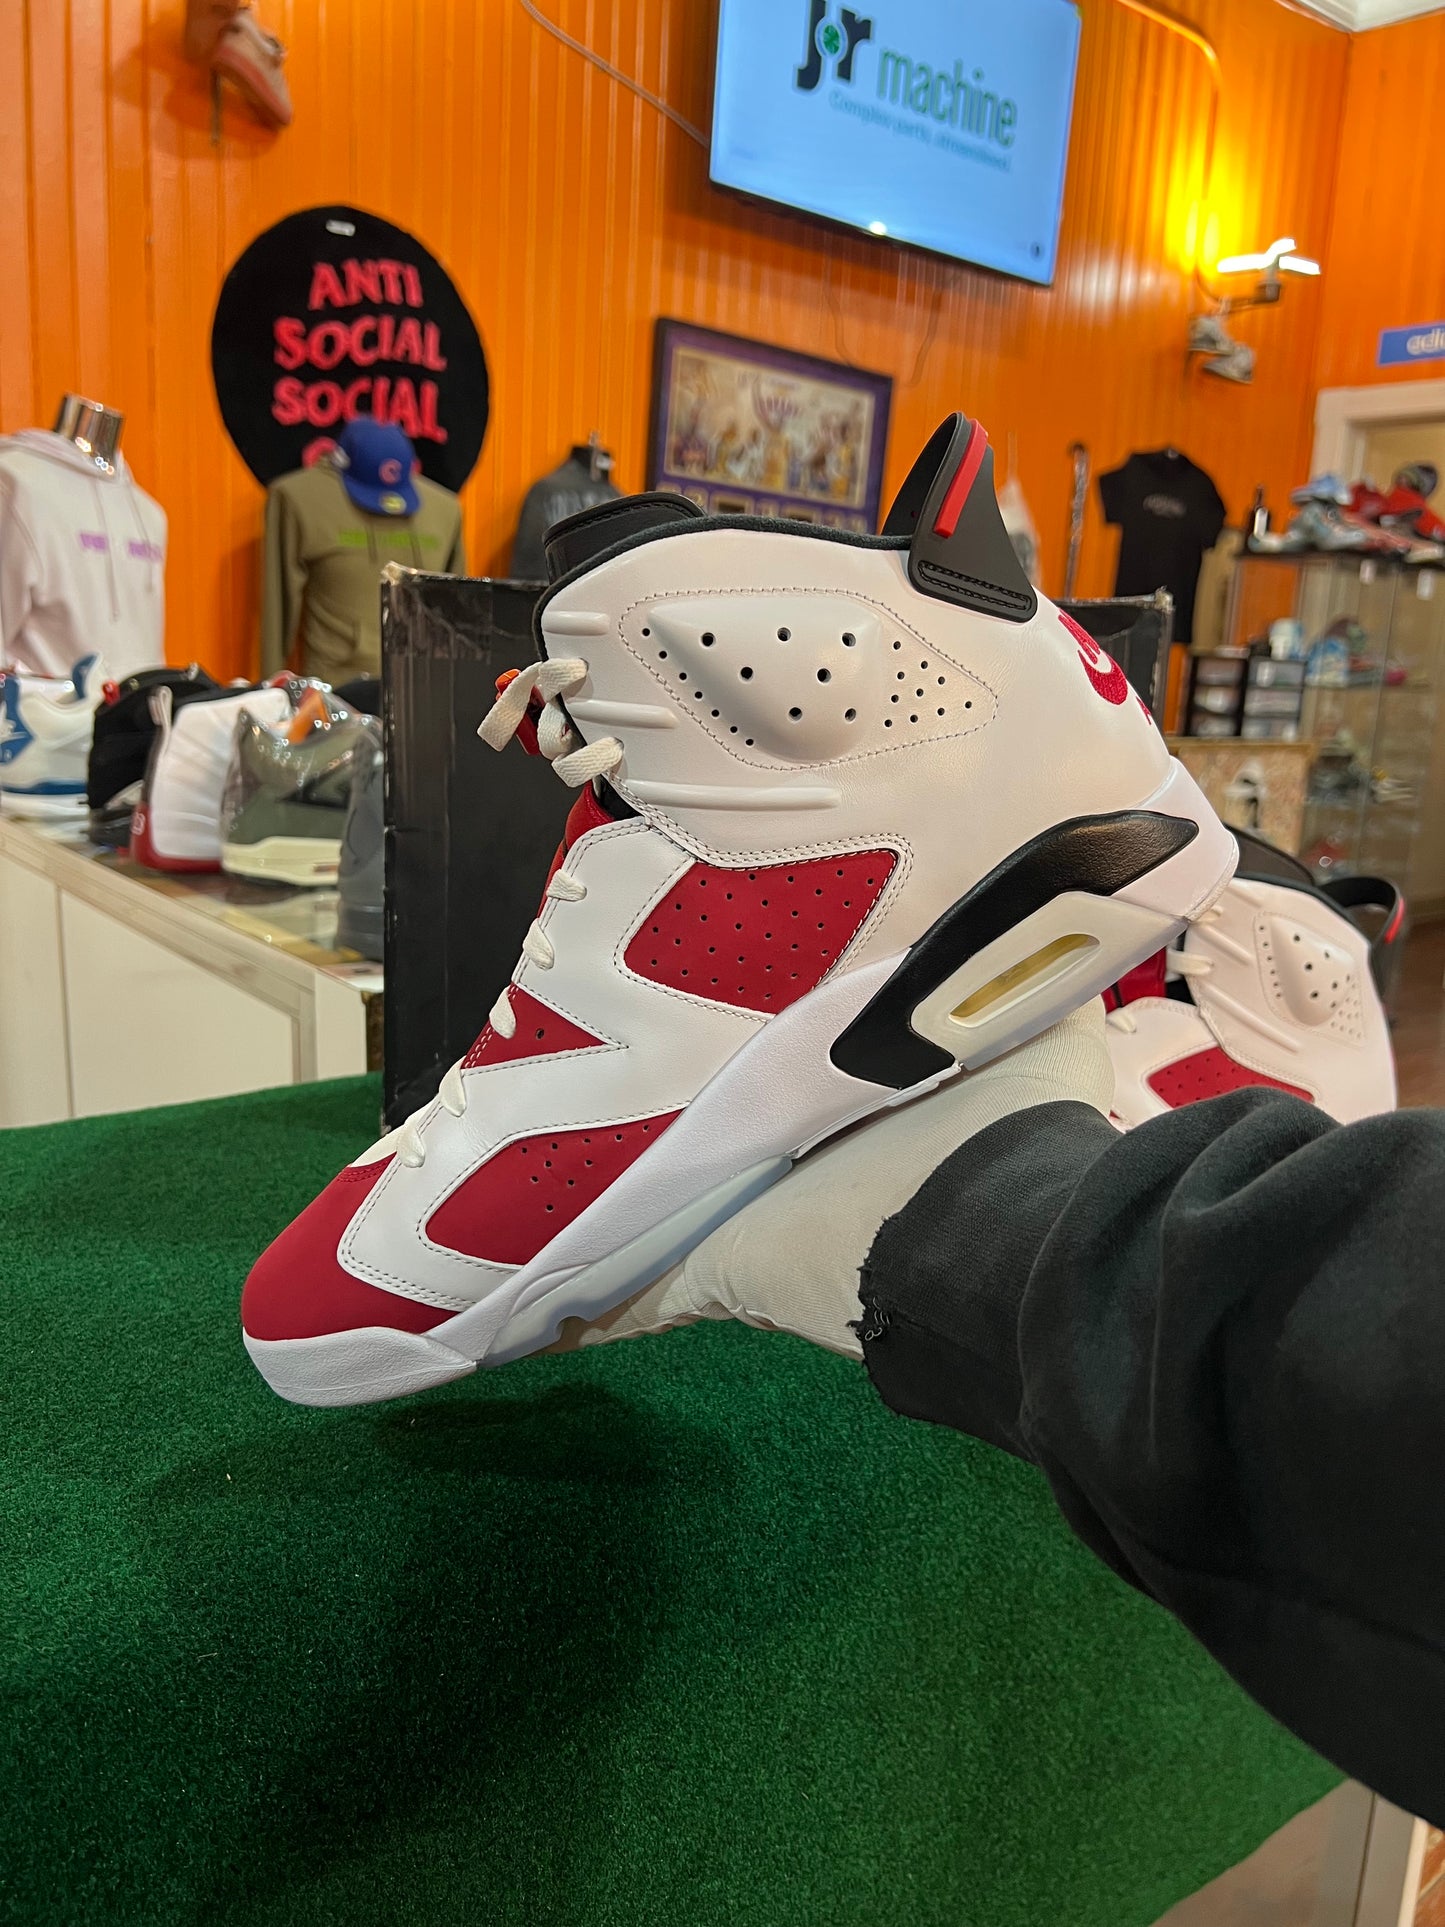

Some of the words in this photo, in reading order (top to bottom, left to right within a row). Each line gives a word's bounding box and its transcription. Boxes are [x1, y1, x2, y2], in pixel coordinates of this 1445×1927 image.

[879, 48, 1018, 148] machine
[308, 258, 424, 310] ANTI
[273, 314, 448, 372] SOCIAL
[271, 375, 448, 444] SOCIAL
